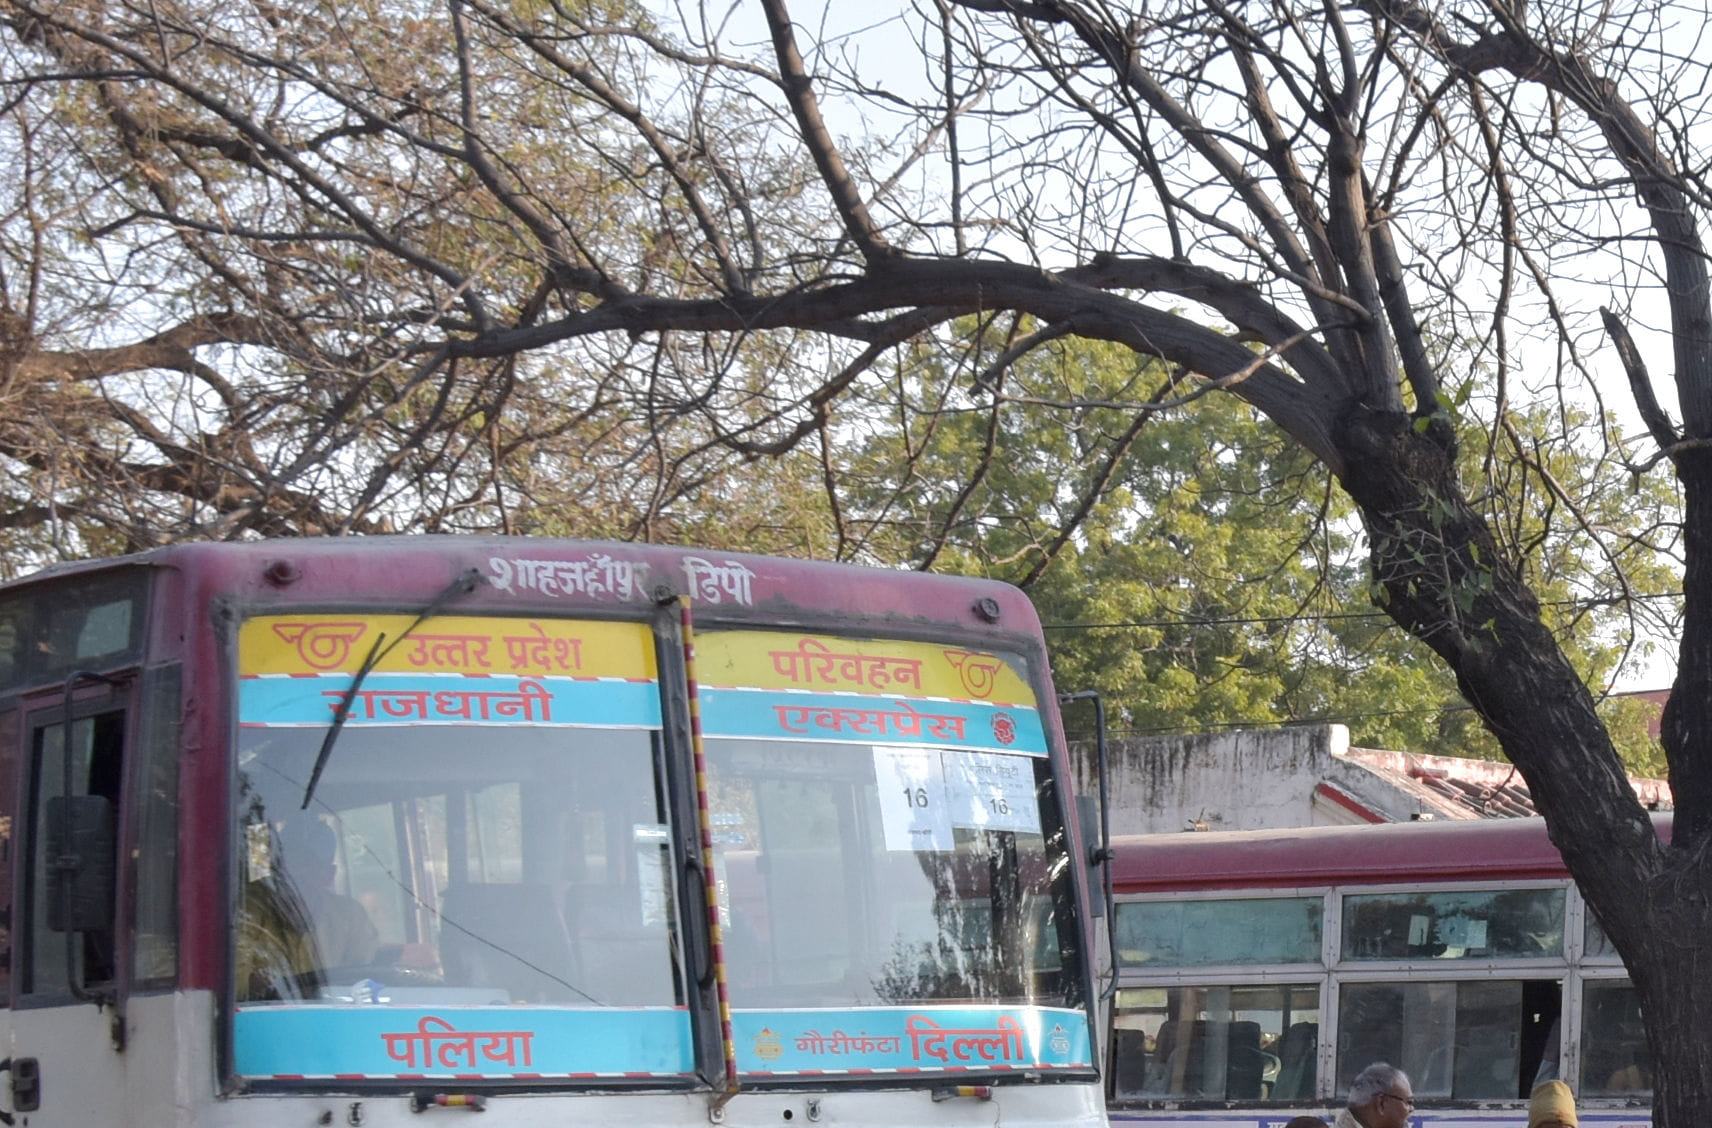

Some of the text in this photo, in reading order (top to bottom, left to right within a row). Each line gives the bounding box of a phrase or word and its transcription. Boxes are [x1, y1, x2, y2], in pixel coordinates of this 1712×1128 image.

[681, 556, 757, 606] डिपो
[404, 622, 582, 670] उत्तर प्रदेश
[768, 638, 923, 690] परिवहन
[322, 681, 554, 721] राजधानी
[772, 701, 968, 741] एक्सप्रेस
[903, 787, 929, 809] 16
[989, 798, 1009, 815] 16
[380, 1015, 535, 1069] पलिया
[794, 1014, 1025, 1062] गौरीफंटा दिल्ली
